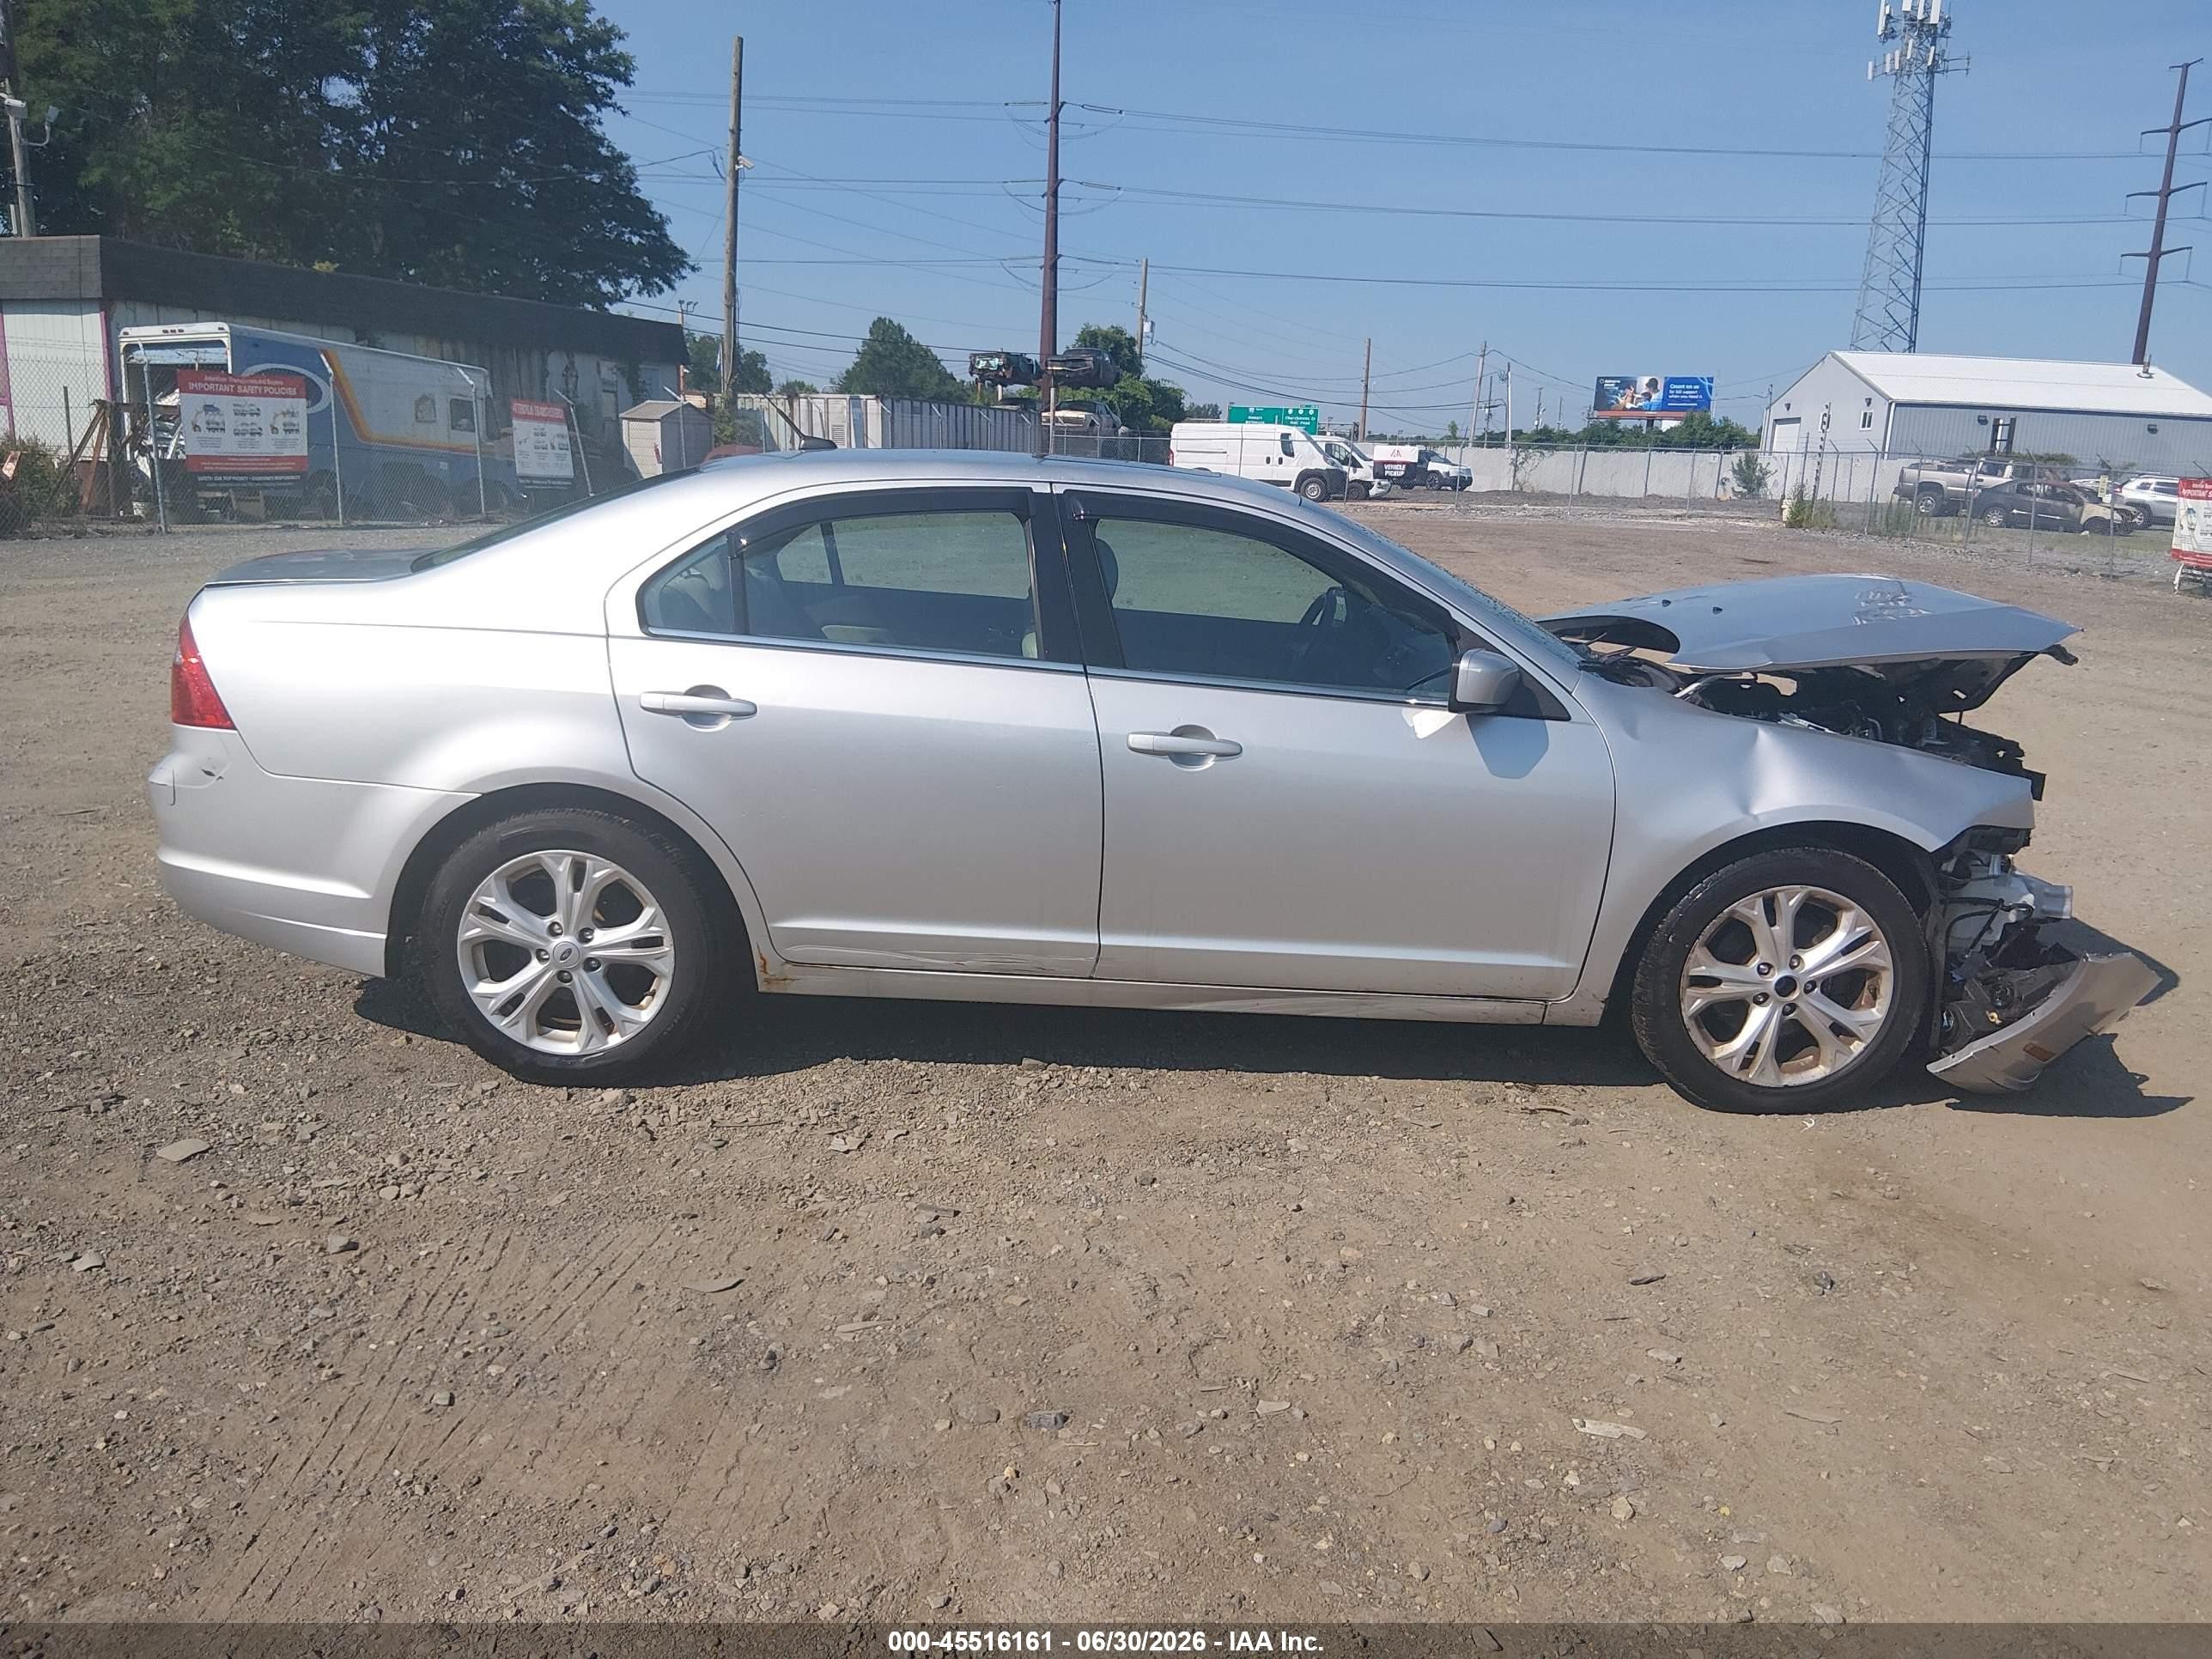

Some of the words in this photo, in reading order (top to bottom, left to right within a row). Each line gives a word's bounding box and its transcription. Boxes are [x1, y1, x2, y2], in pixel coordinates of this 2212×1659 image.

[188, 381, 234, 392] IMPORTANT
[237, 386, 263, 394] SAFETY
[264, 386, 297, 396] POLICIES
